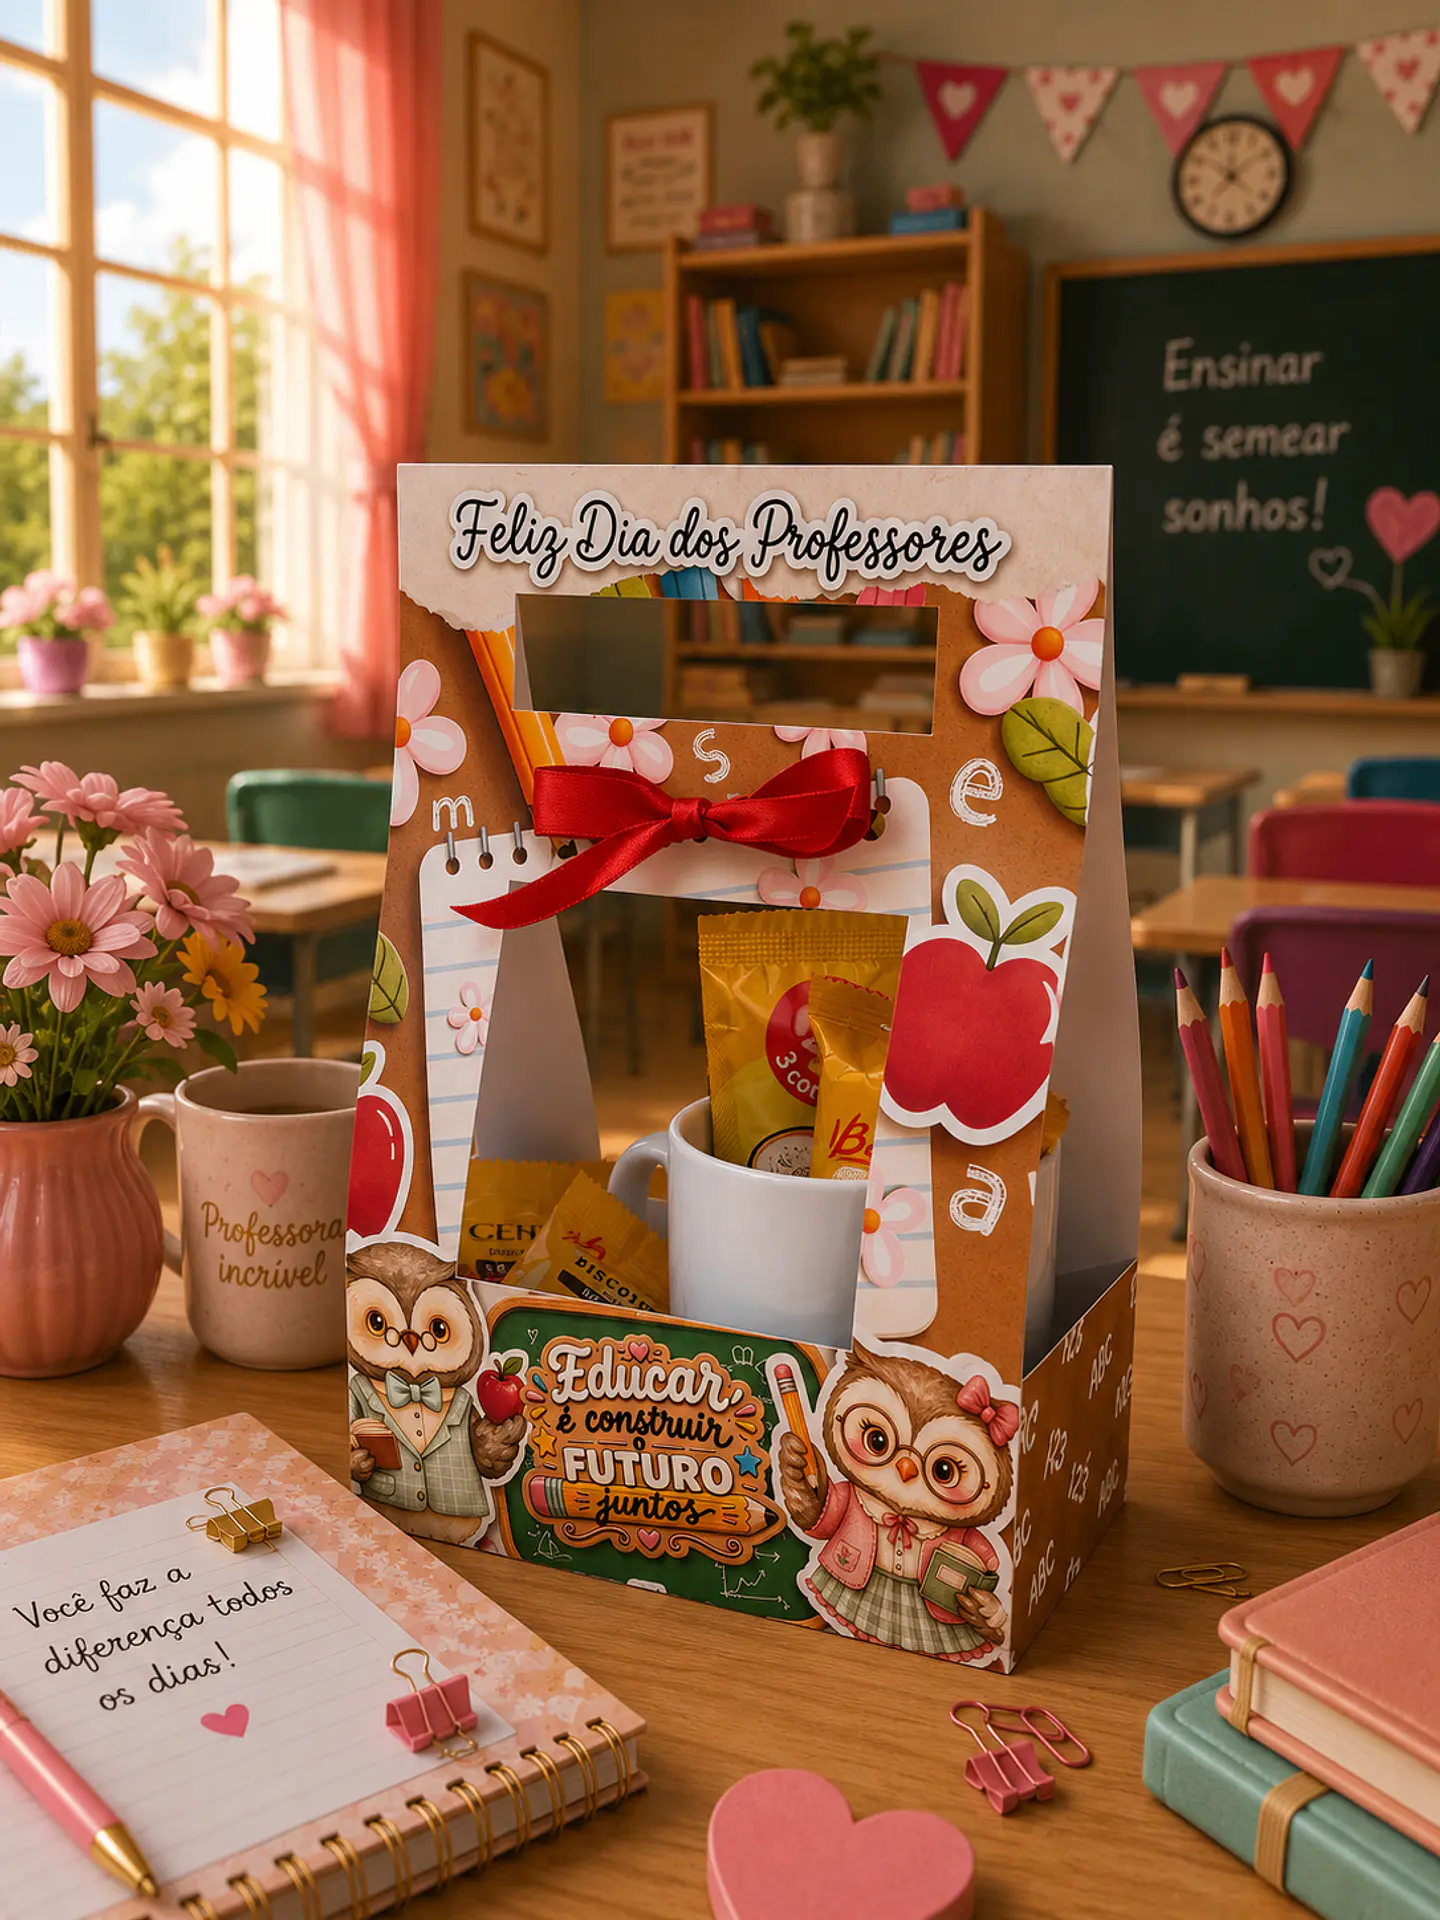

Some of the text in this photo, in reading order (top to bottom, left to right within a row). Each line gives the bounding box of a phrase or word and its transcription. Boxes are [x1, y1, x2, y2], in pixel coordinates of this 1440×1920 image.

[1162, 337, 1325, 392] Ensinar
[1156, 412, 1351, 462] é semear
[1161, 476, 1329, 533] sonhos!
[454, 497, 1003, 584] Feliz Dia dos Professores
[432, 795, 474, 831] m
[950, 758, 1004, 827] e
[775, 1051, 798, 1070] 3
[201, 1201, 344, 1256] Professora
[469, 1223, 543, 1242] CEN
[219, 1250, 328, 1289] incrível
[549, 1344, 737, 1412] Educar
[556, 1406, 733, 1449] é construir
[633, 1437, 645, 1451] o
[562, 1447, 734, 1495] FUTURO
[596, 1488, 716, 1525] juntos
[12, 1566, 191, 1629] Você faz a
[1027, 1539, 1055, 1617] ABC
[45, 1578, 293, 1674] diferença todos
[99, 1641, 236, 1711] os dias!
